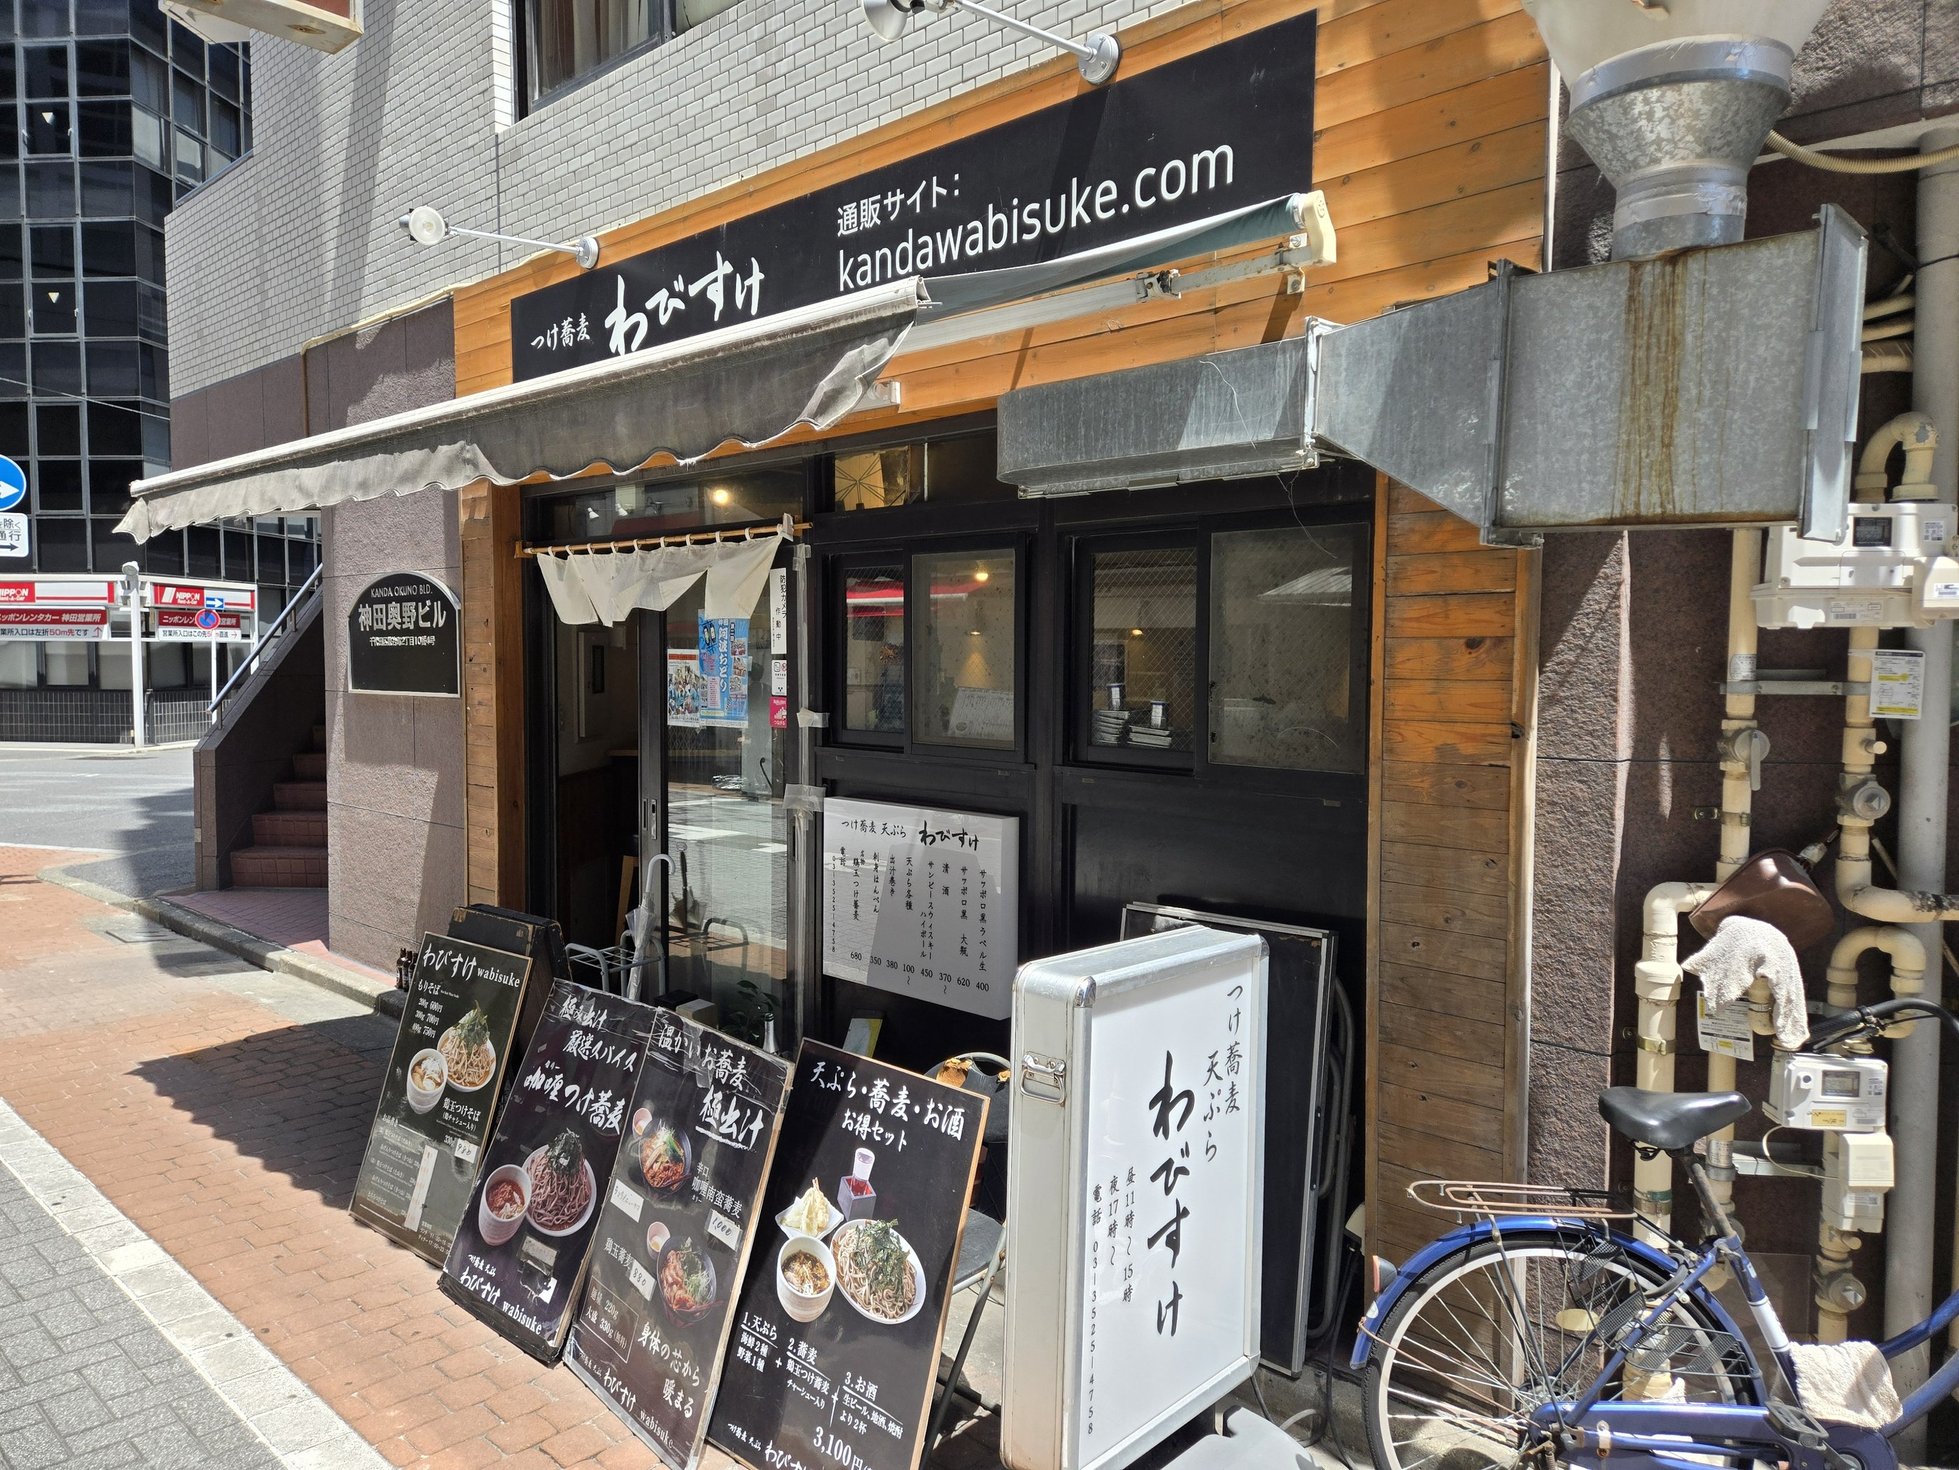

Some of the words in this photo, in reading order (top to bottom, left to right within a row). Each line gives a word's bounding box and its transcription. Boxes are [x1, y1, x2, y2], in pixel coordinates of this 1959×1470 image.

[839, 143, 1233, 291] kandawabisuke.com
[531, 313, 591, 351] つけ蕎麦
[604, 250, 765, 356] わびすけ
[176, 591, 200, 600] NIPPON
[370, 586, 393, 598] KANDA
[393, 584, 417, 596] OKUNO
[419, 583, 433, 595] BLD.
[162, 615, 196, 624] ニッポンレン
[358, 600, 446, 631] 神田奥野ビル
[0, 628, 89, 636] 業所入口は左折50m先です
[841, 820, 877, 835] つけ蕎麦
[881, 822, 907, 838] 天ぷら
[919, 821, 980, 851] わびすけ
[423, 943, 477, 981] わびすけ
[477, 967, 520, 988] wabisuke
[850, 951, 862, 961] 680
[870, 957, 882, 966] 350
[886, 959, 898, 970] 380
[902, 963, 915, 975] 100
[920, 968, 933, 979] 450
[939, 972, 952, 984] 370
[417, 979, 441, 996] もりそば
[957, 976, 970, 988] 620
[976, 982, 990, 992] 400
[1224, 984, 1243, 1115] つけ蕎麦
[1202, 1050, 1223, 1163] 天ぷら
[842, 1108, 907, 1152] お得セット
[1091, 1183, 1102, 1226] 電話
[1147, 1049, 1196, 1337] わびすけ
[460, 1266, 501, 1305] わびすけ
[502, 1301, 542, 1335] wabisuke
[638, 1321, 700, 1387] 身体の芯から
[603, 1367, 636, 1412] わびすけ
[639, 1409, 674, 1449] wabisuke
